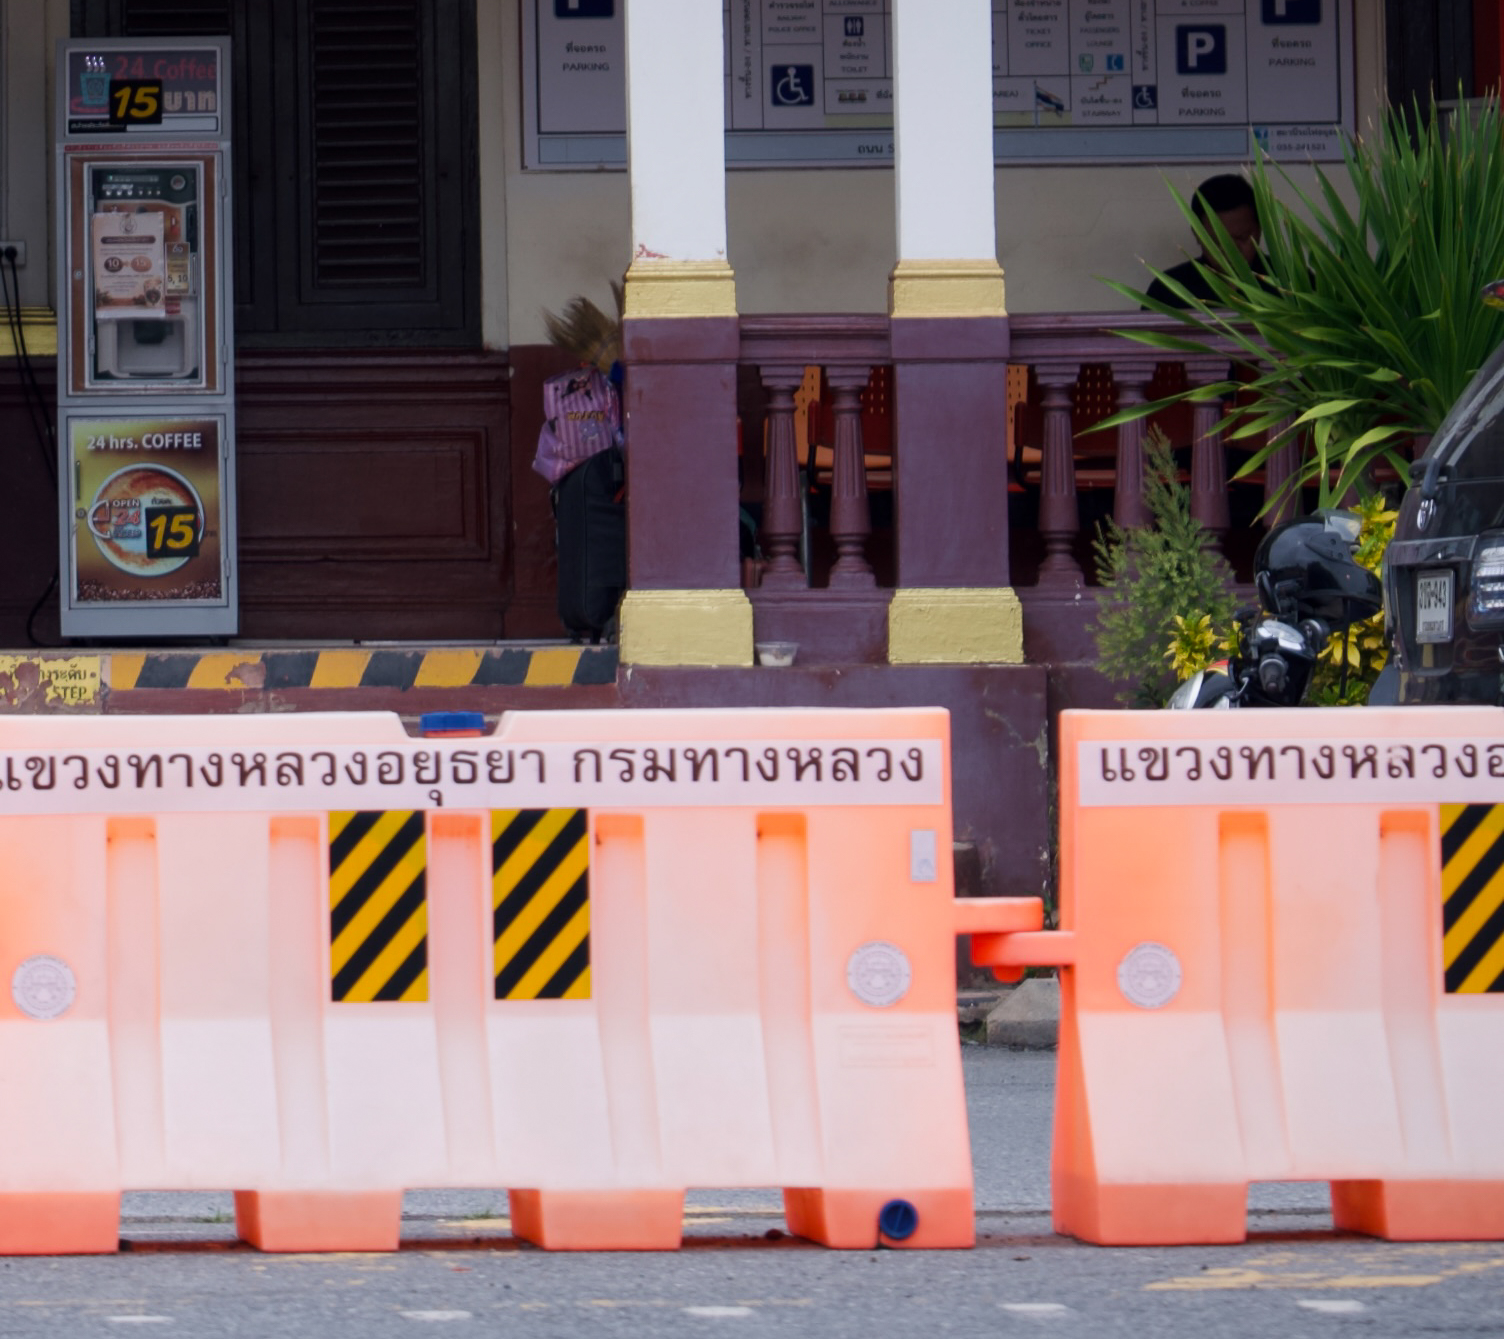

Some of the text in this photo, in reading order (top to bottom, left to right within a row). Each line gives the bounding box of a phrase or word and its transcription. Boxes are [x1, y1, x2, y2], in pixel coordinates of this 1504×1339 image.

[566, 42, 607, 54] ที่จอดรถ
[1271, 37, 1312, 49] ที่จอดรถ
[563, 61, 609, 72] PARKING
[1268, 57, 1316, 67] PARKING
[154, 58, 217, 80] Coffee
[1181, 87, 1222, 99] ที่จอดรถ
[113, 86, 160, 119] 15
[164, 90, 216, 112] บาท
[1178, 107, 1225, 117] PARKING
[87, 432, 202, 450] 24 hrs. COFFEE
[112, 499, 141, 507] OPEN
[150, 514, 195, 550] 15
[571, 744, 924, 784] กรมทางหลวง
